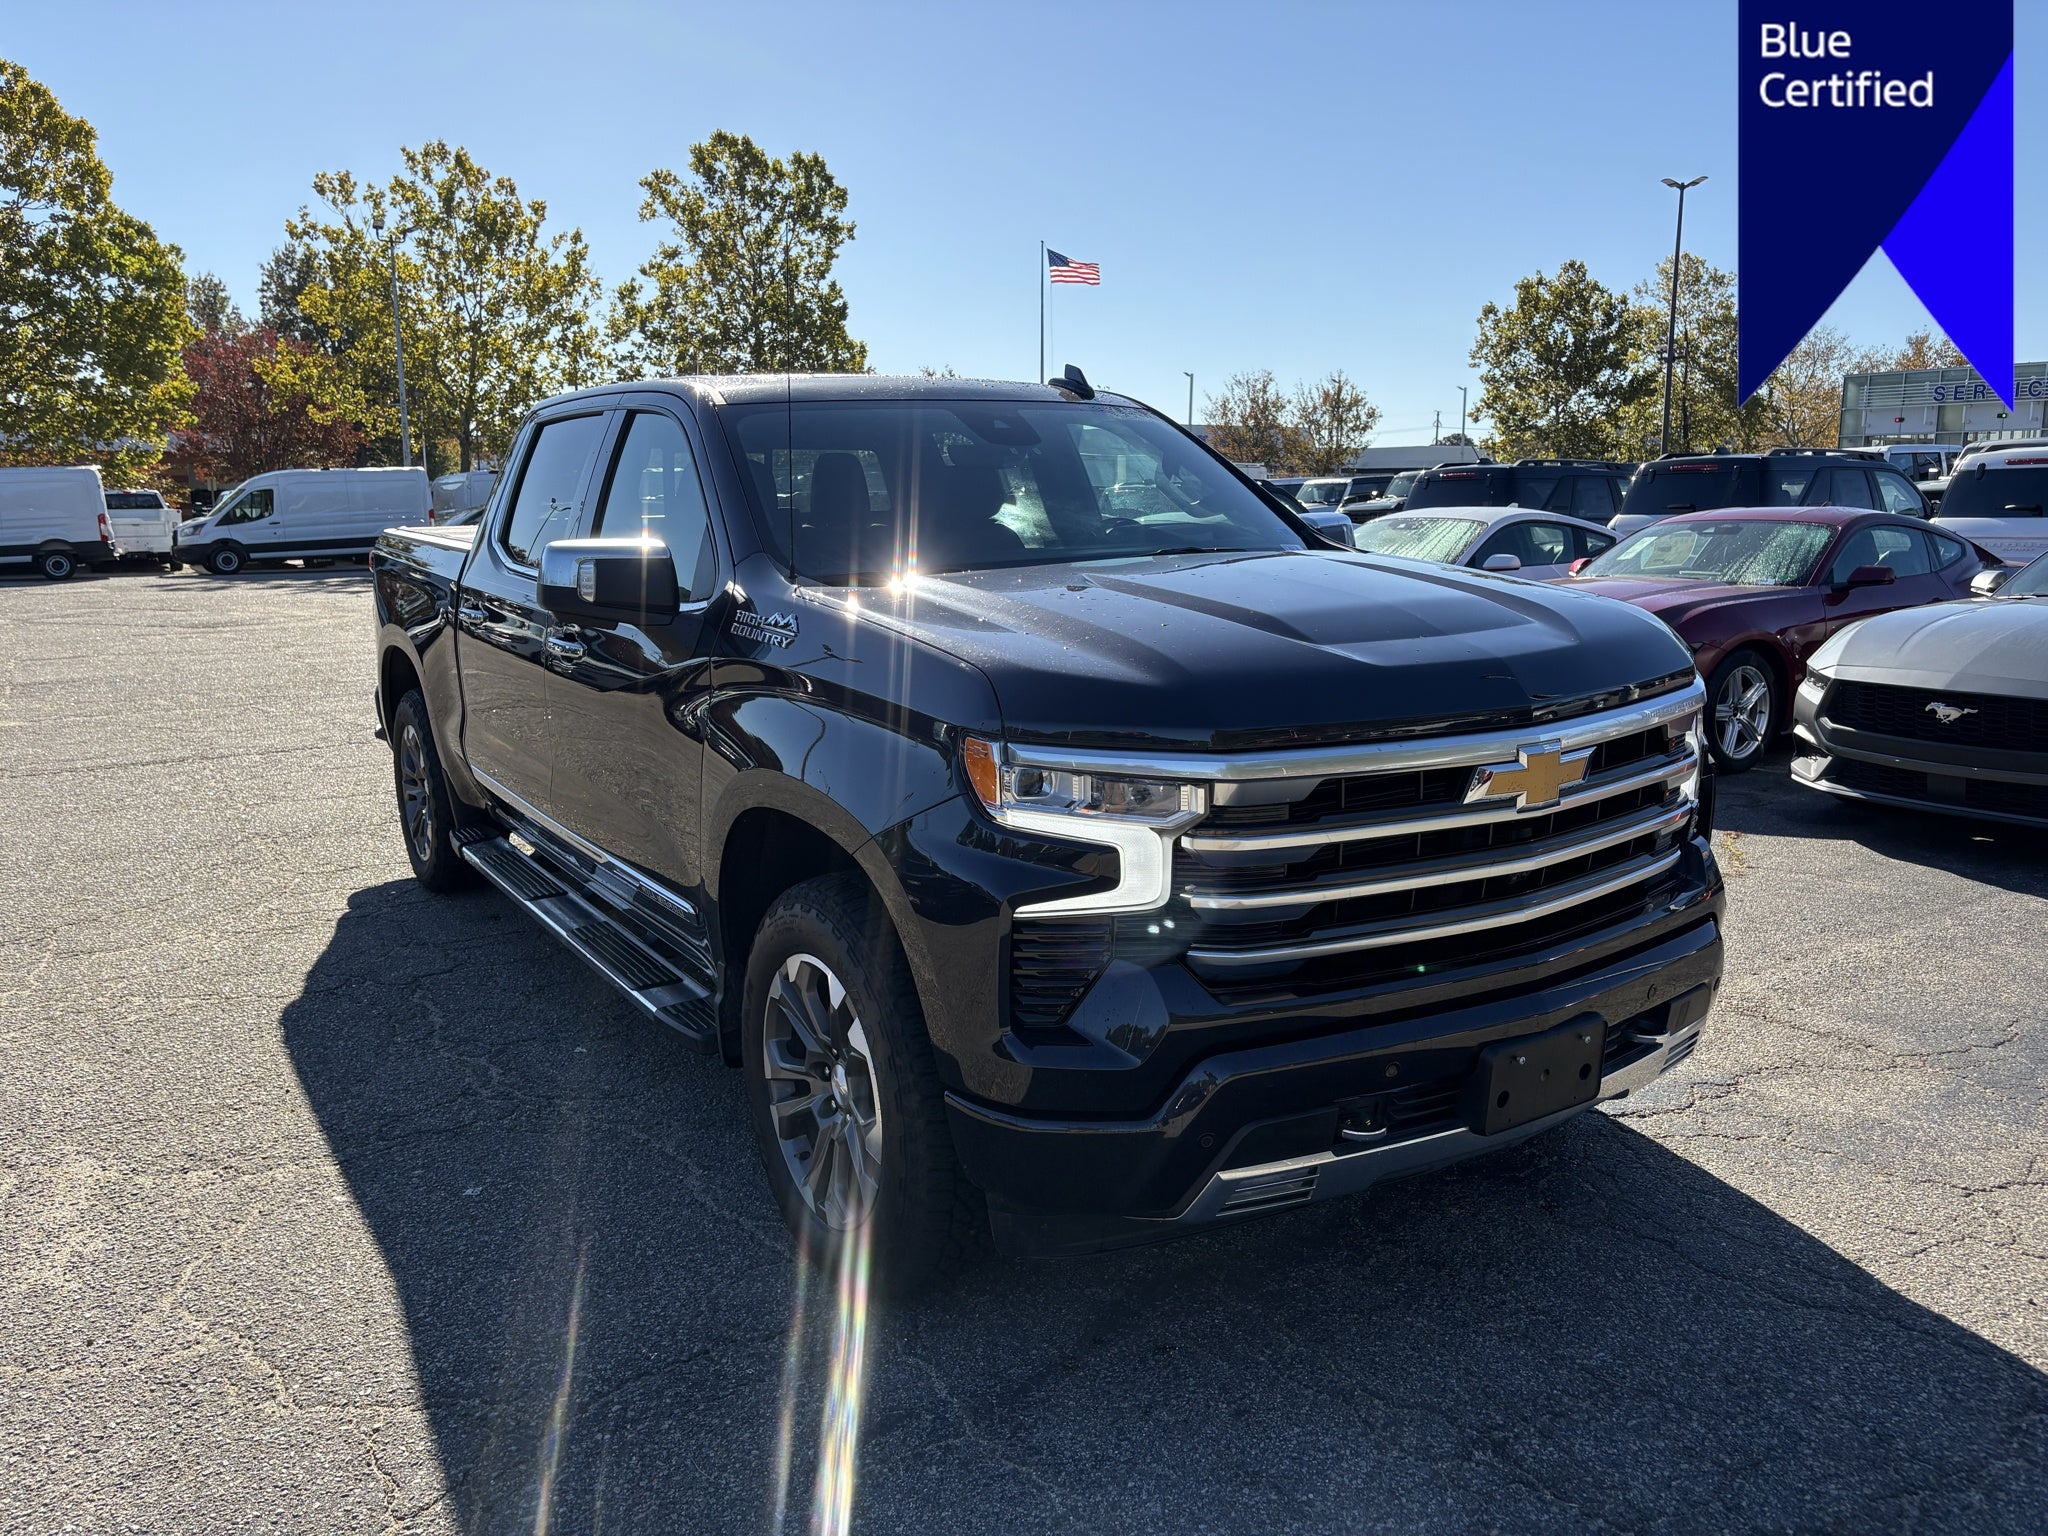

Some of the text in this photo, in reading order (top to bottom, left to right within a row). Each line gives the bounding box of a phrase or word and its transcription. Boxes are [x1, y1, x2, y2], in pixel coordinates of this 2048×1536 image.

[1933, 380, 2048, 402] SERIC
[735, 610, 766, 628] HIGH
[730, 622, 792, 649] COUNTRY
